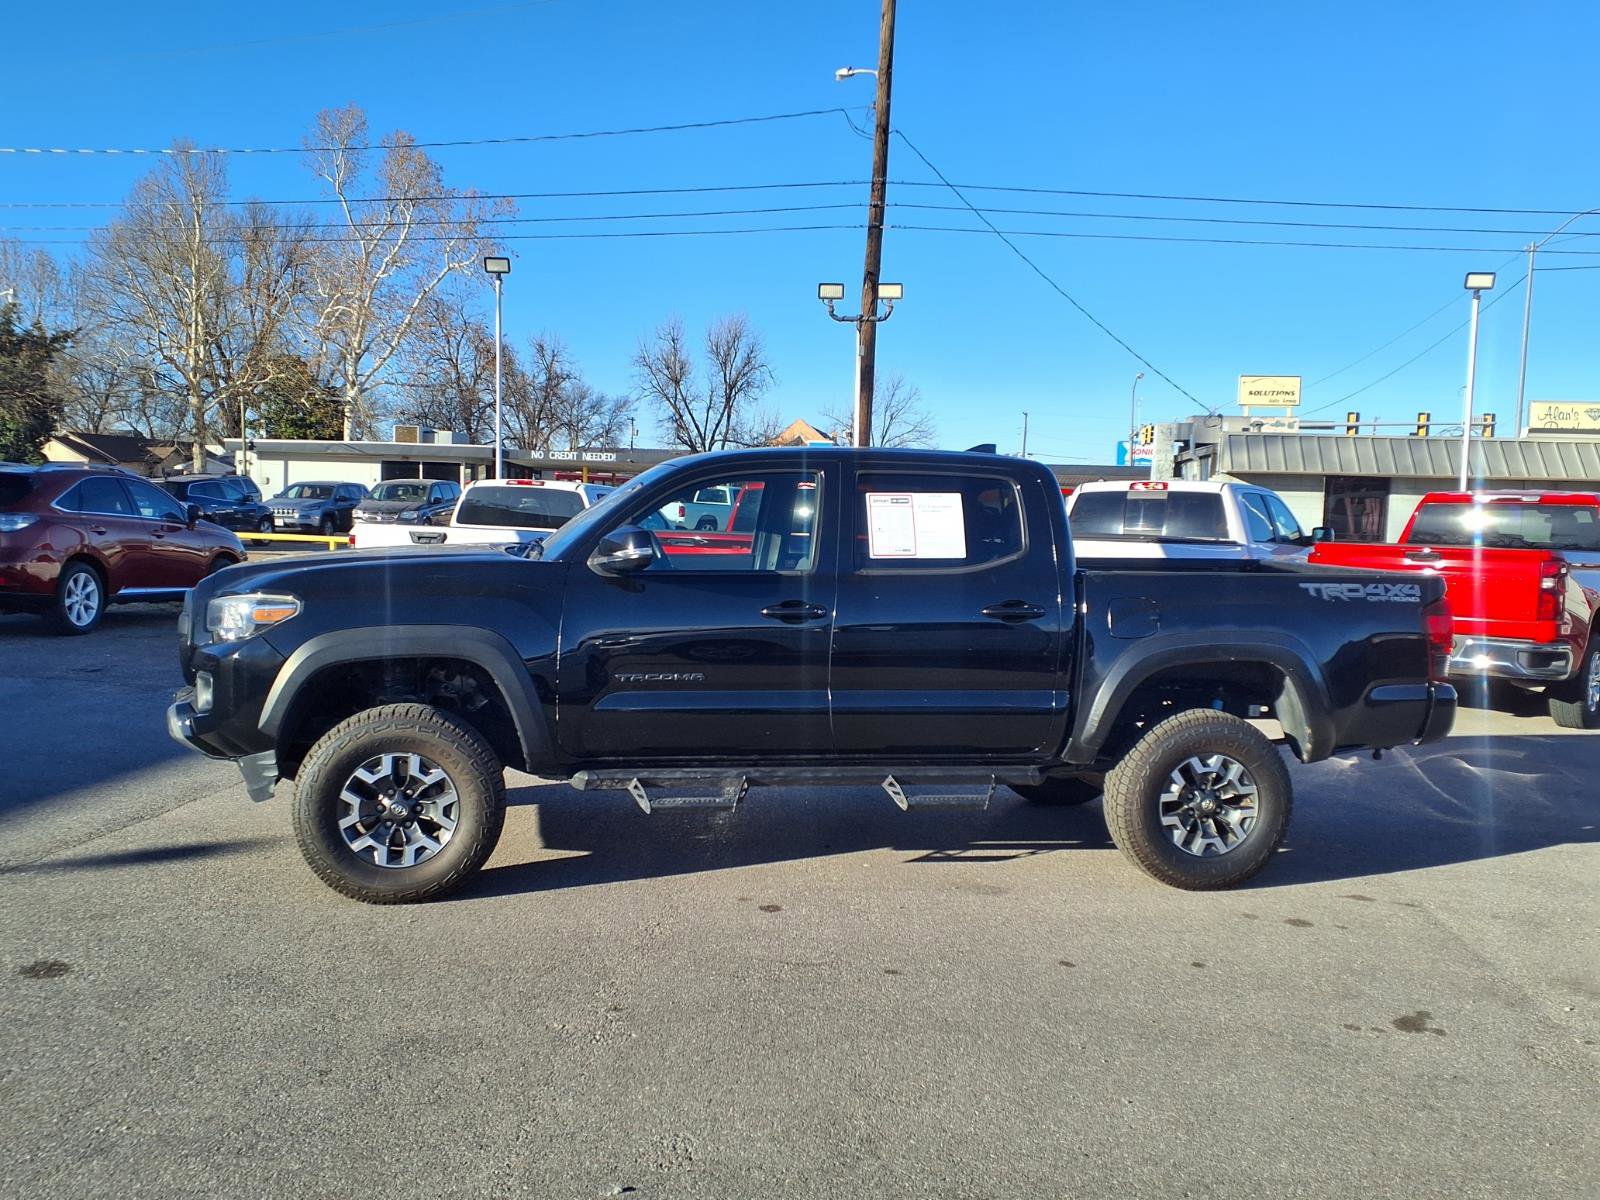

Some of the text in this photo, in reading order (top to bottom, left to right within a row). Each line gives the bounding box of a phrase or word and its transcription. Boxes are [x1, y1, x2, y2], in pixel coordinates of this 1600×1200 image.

[1537, 405, 1580, 421] Alan's
[531, 450, 617, 461] NO CREDIT NEEDED!
[1299, 582, 1366, 602] TRD
[614, 673, 705, 683] TACOMA
